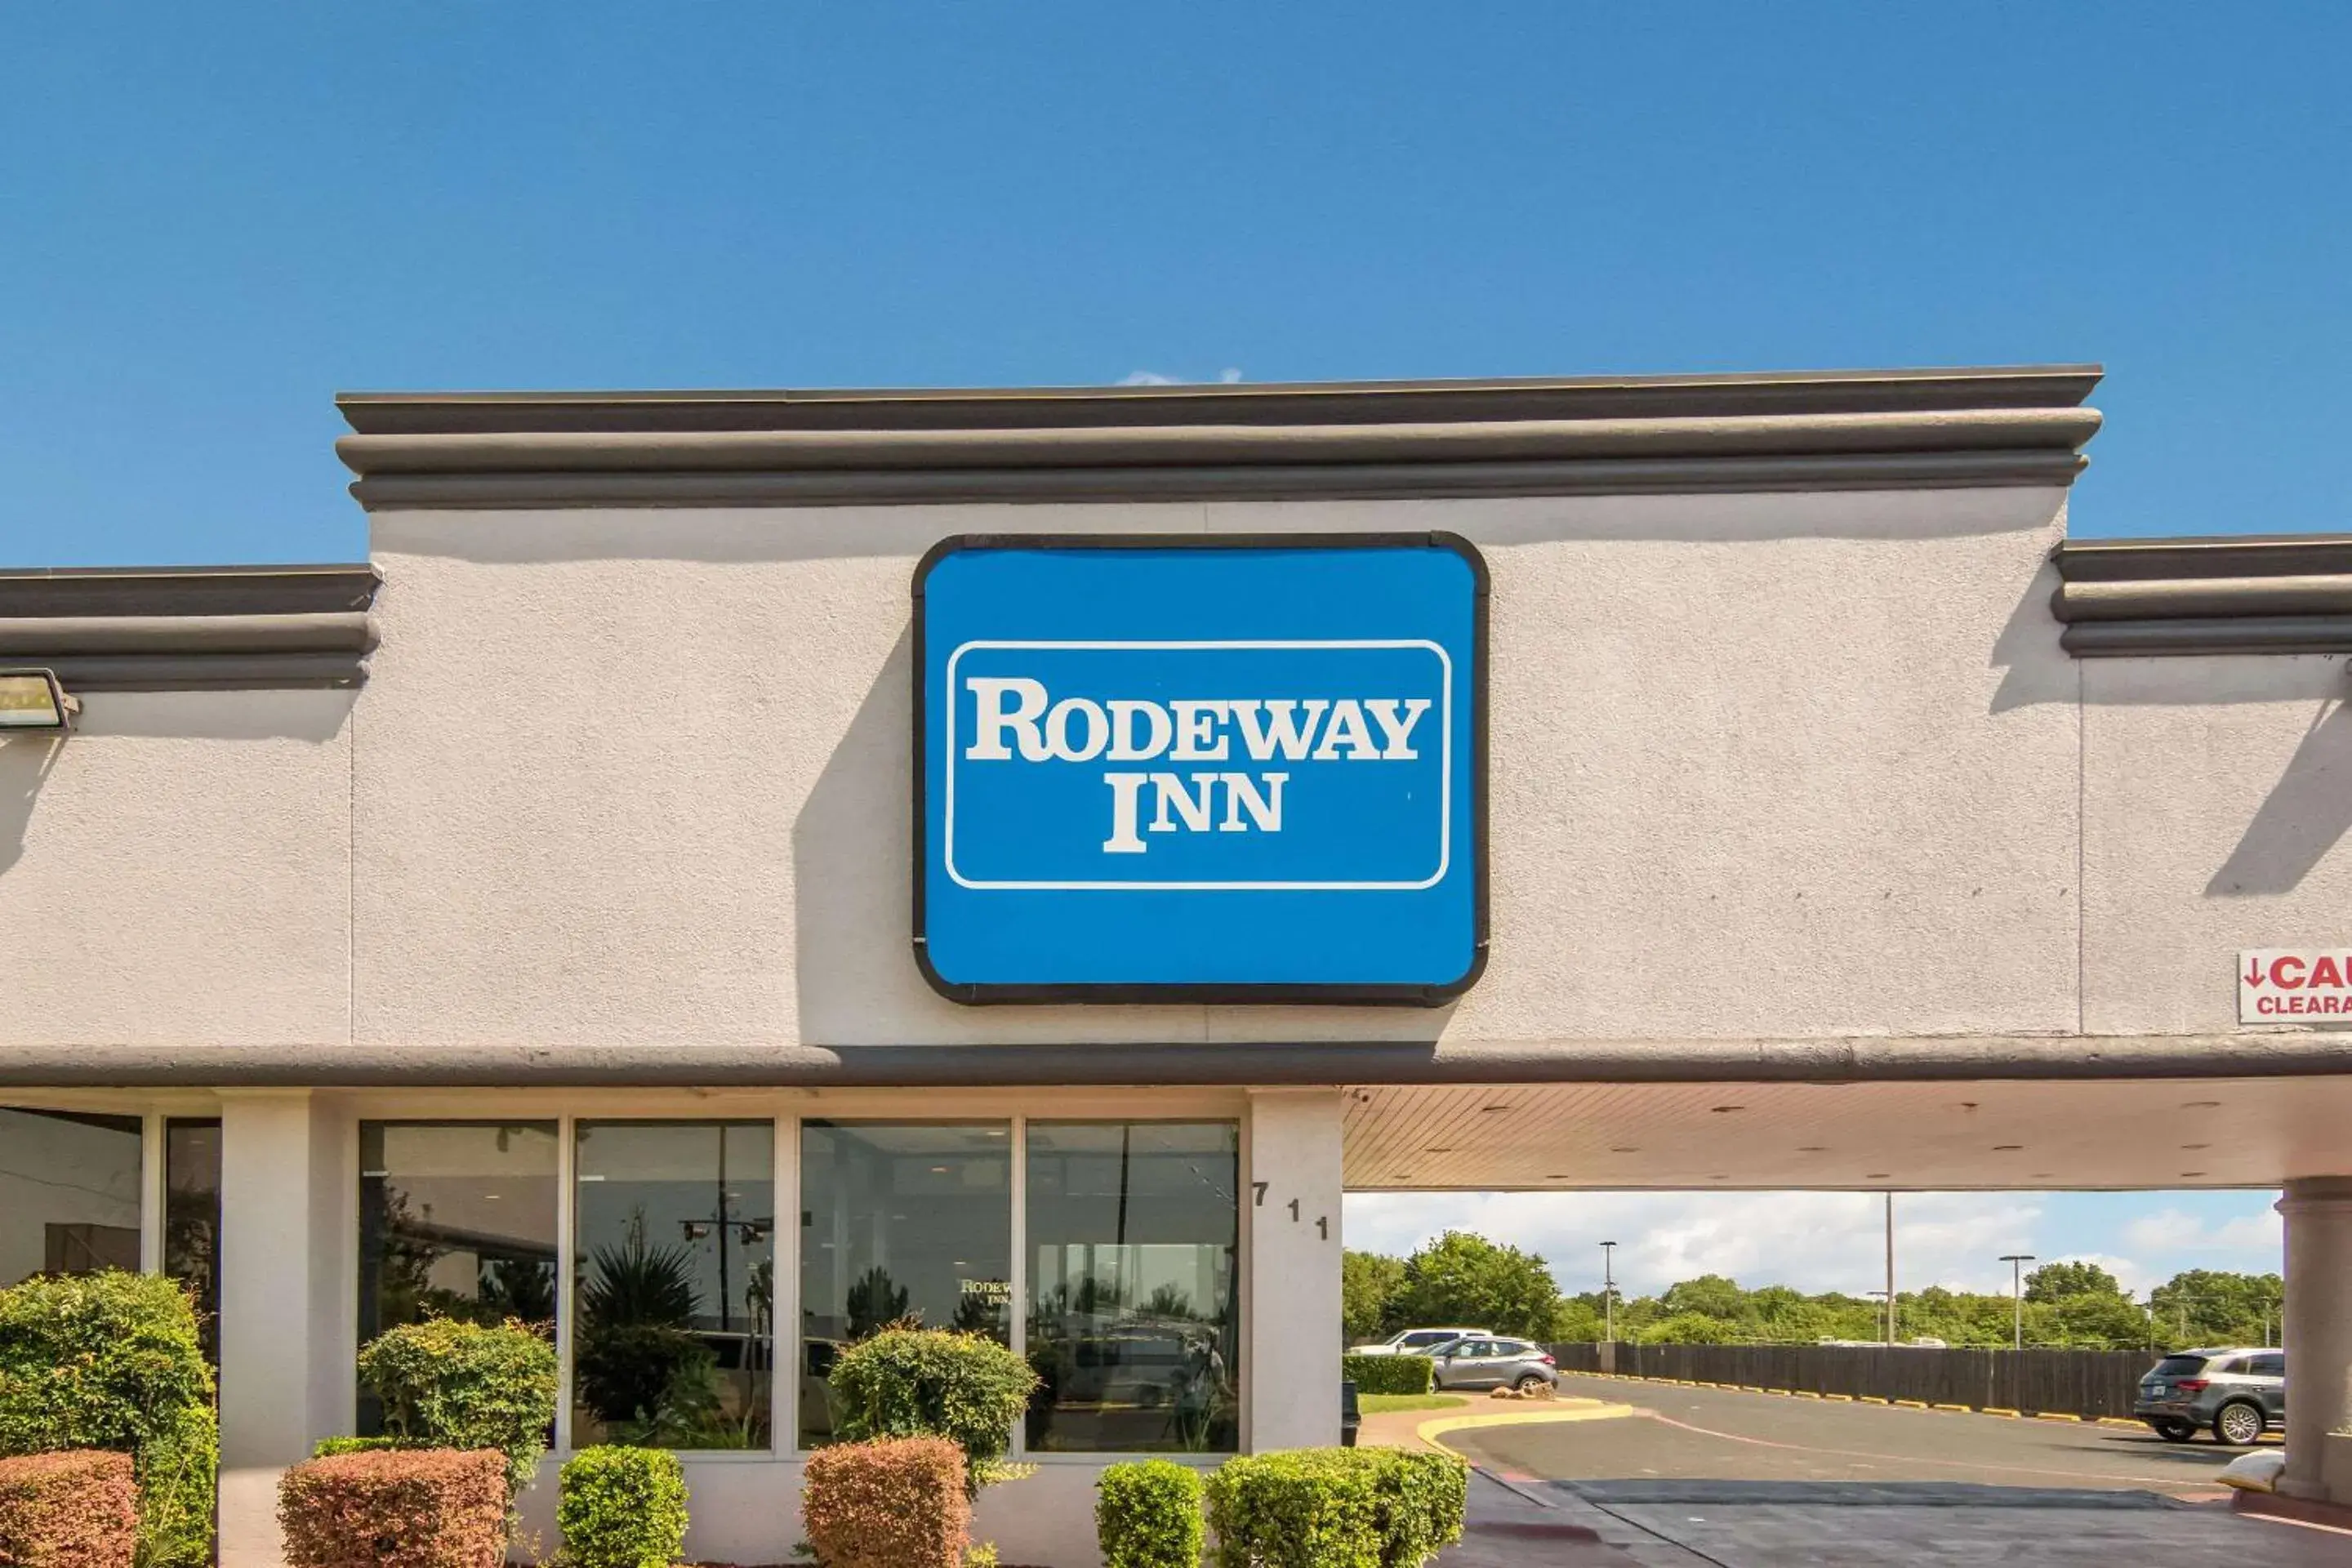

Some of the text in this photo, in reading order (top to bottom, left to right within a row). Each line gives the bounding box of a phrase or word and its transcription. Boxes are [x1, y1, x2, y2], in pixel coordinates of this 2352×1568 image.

[965, 677, 1431, 762] RODEWAY
[1103, 773, 1289, 853] INN
[2270, 956, 2352, 990] CA
